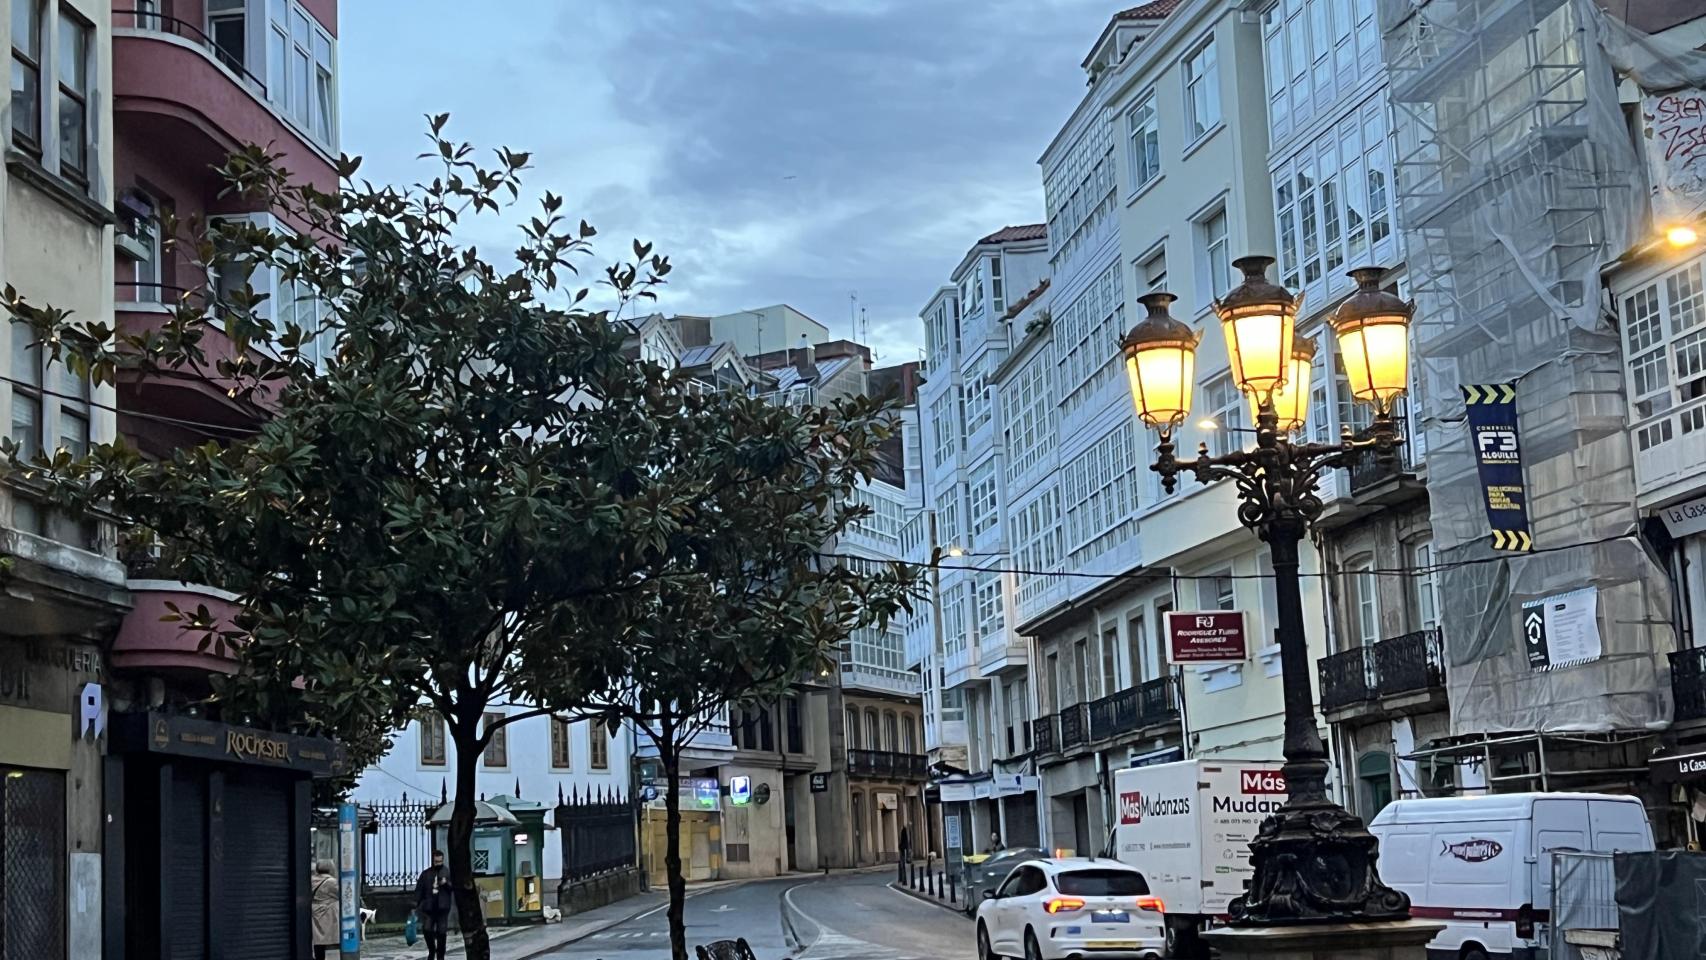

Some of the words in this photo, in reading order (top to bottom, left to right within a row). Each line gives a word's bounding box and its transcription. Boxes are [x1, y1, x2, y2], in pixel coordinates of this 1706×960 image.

[1478, 431, 1517, 451] F3
[1482, 451, 1519, 459] ALQUILER
[1667, 510, 1683, 523] La
[1679, 760, 1688, 773] La
[1243, 772, 1286, 791] Más
[1121, 795, 1140, 819] Más
[1141, 792, 1190, 817] Mudanzas
